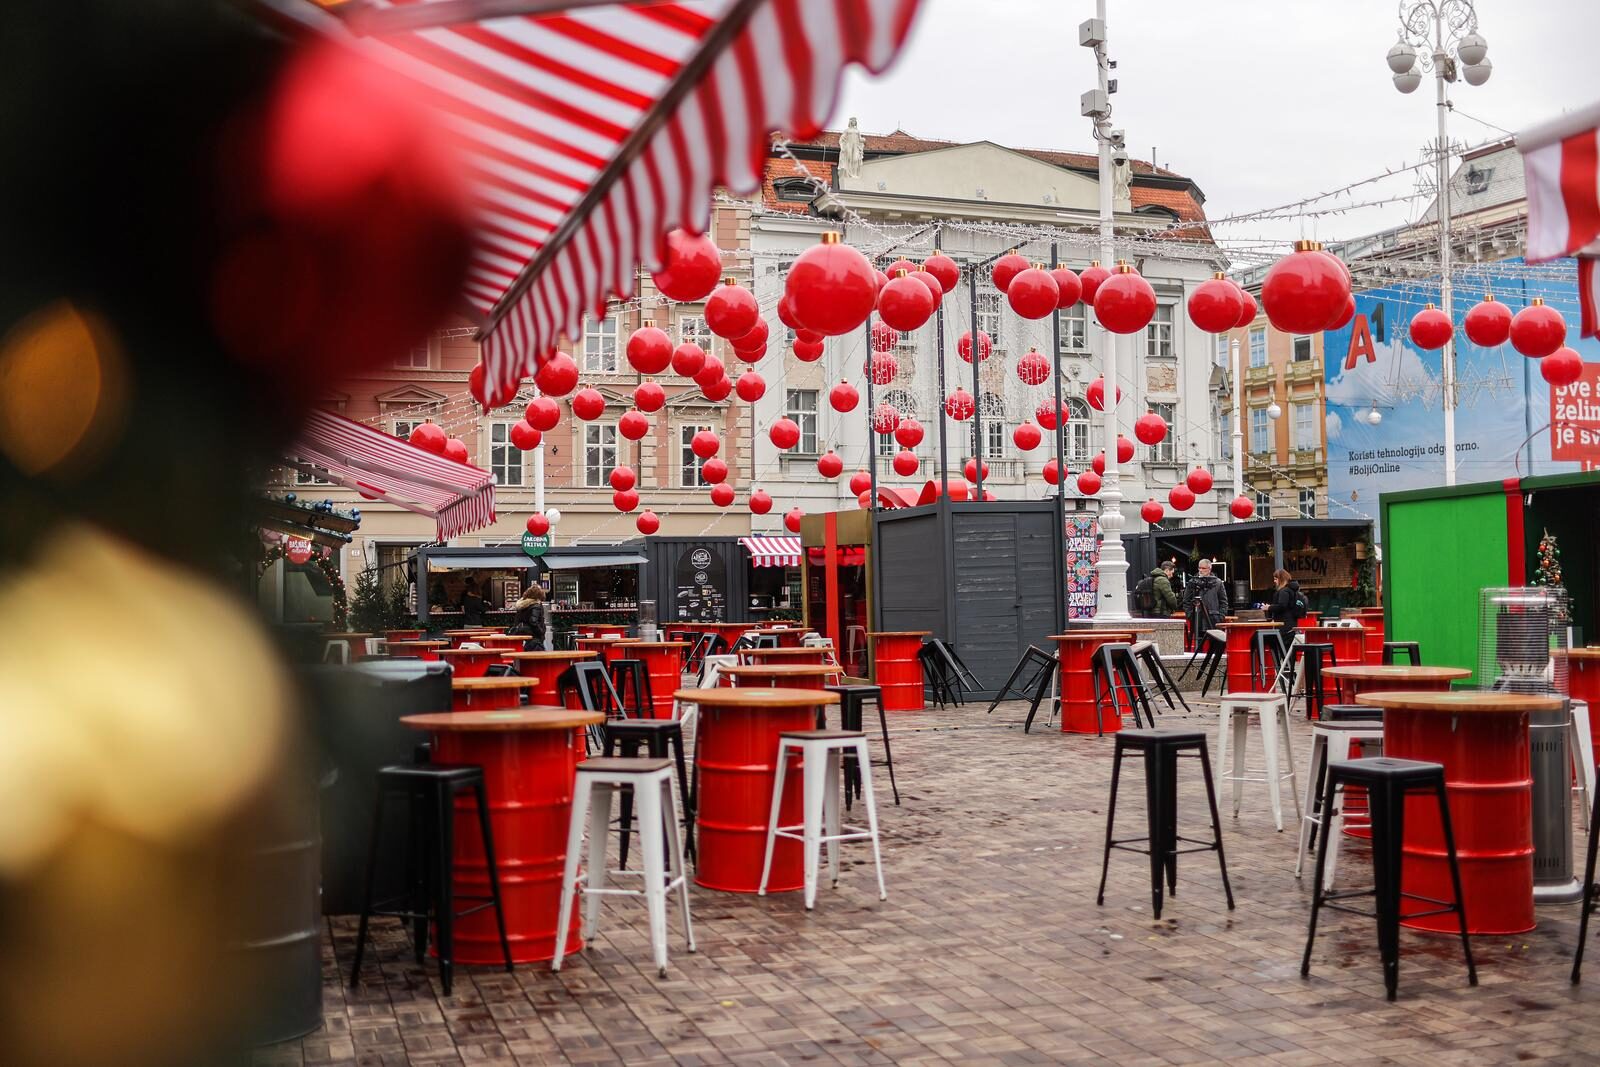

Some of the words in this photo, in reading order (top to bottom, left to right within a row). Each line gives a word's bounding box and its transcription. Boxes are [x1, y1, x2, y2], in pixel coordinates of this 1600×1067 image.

[1345, 302, 1384, 370] A1
[1556, 422, 1575, 449] je
[1348, 450, 1375, 461] Koristi
[1377, 445, 1425, 458] tehnologiju
[1428, 442, 1479, 456] odgorno.
[1348, 463, 1401, 475] #BoljiOnline
